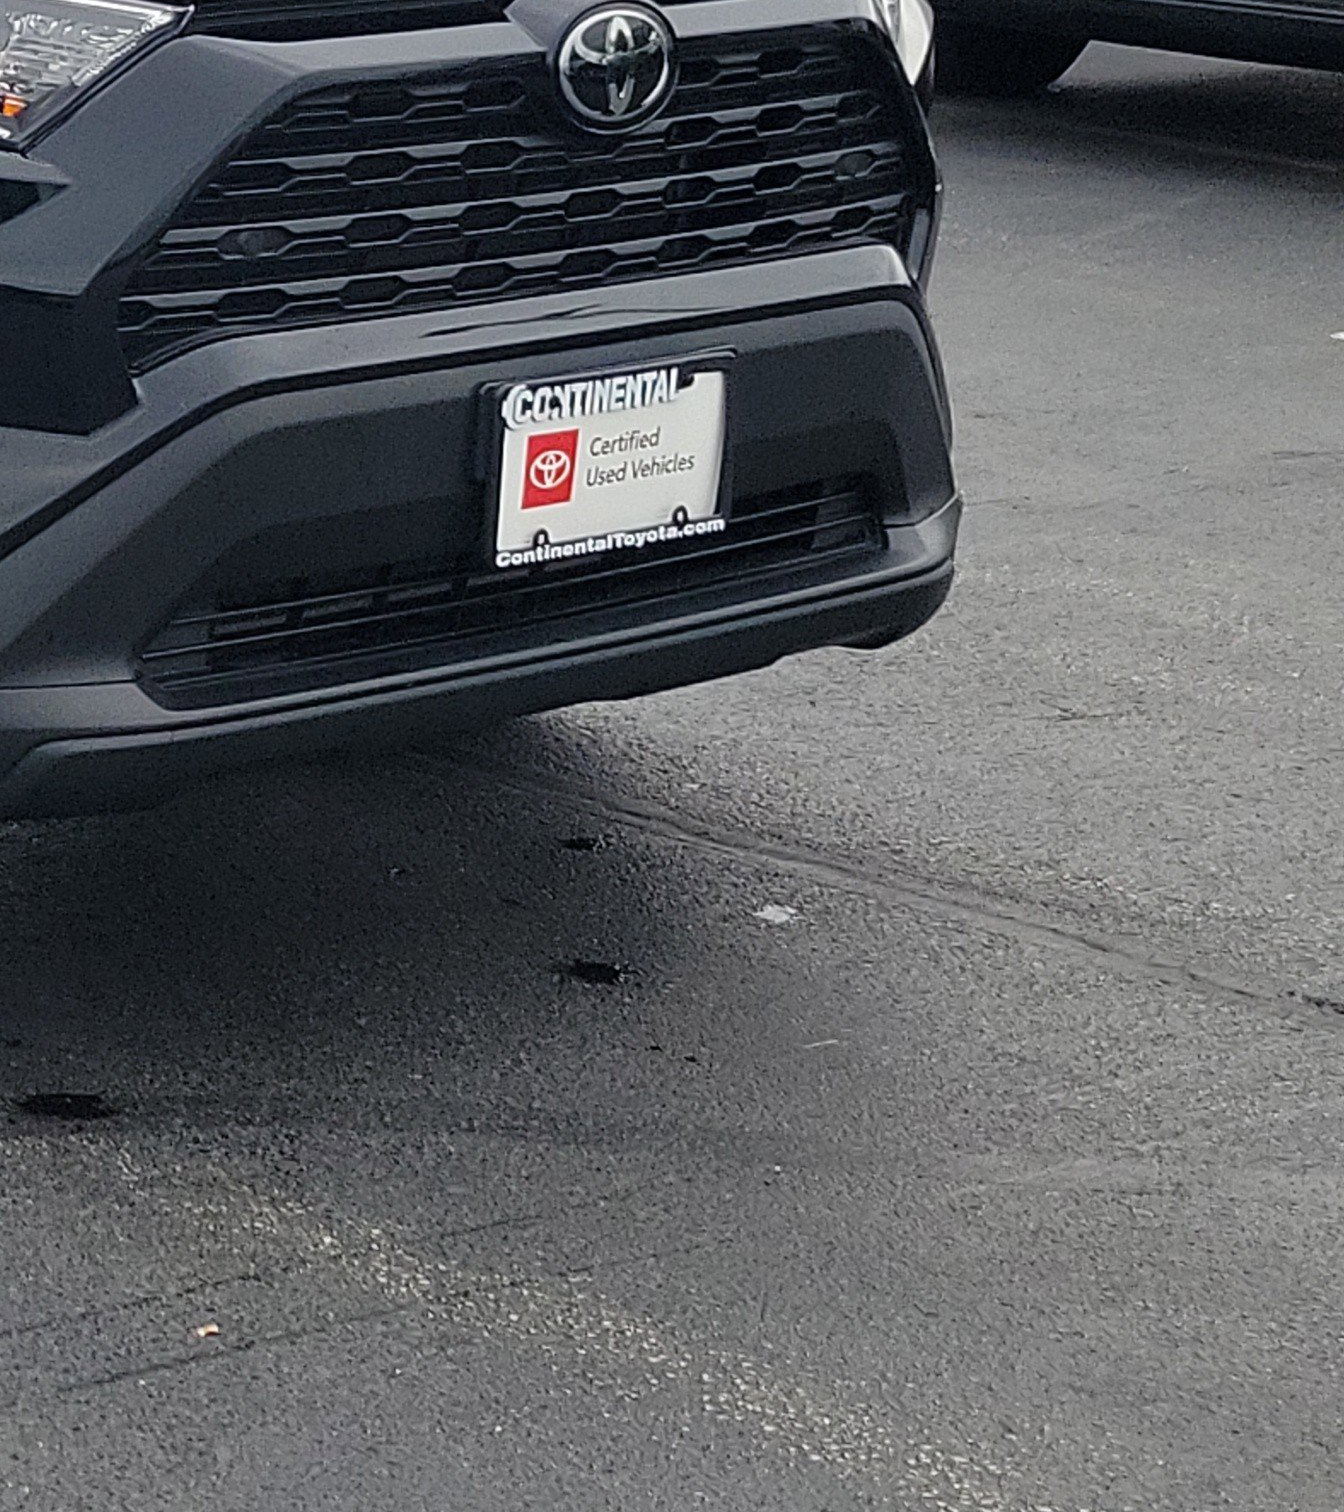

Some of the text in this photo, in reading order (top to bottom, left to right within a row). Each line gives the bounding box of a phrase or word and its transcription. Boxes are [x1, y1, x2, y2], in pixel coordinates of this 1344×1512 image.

[512, 367, 679, 424] CONTINENTAL
[589, 426, 661, 456] Certified
[586, 453, 695, 487] Used Vehicles
[495, 517, 725, 568] ContinentalToyota.com
